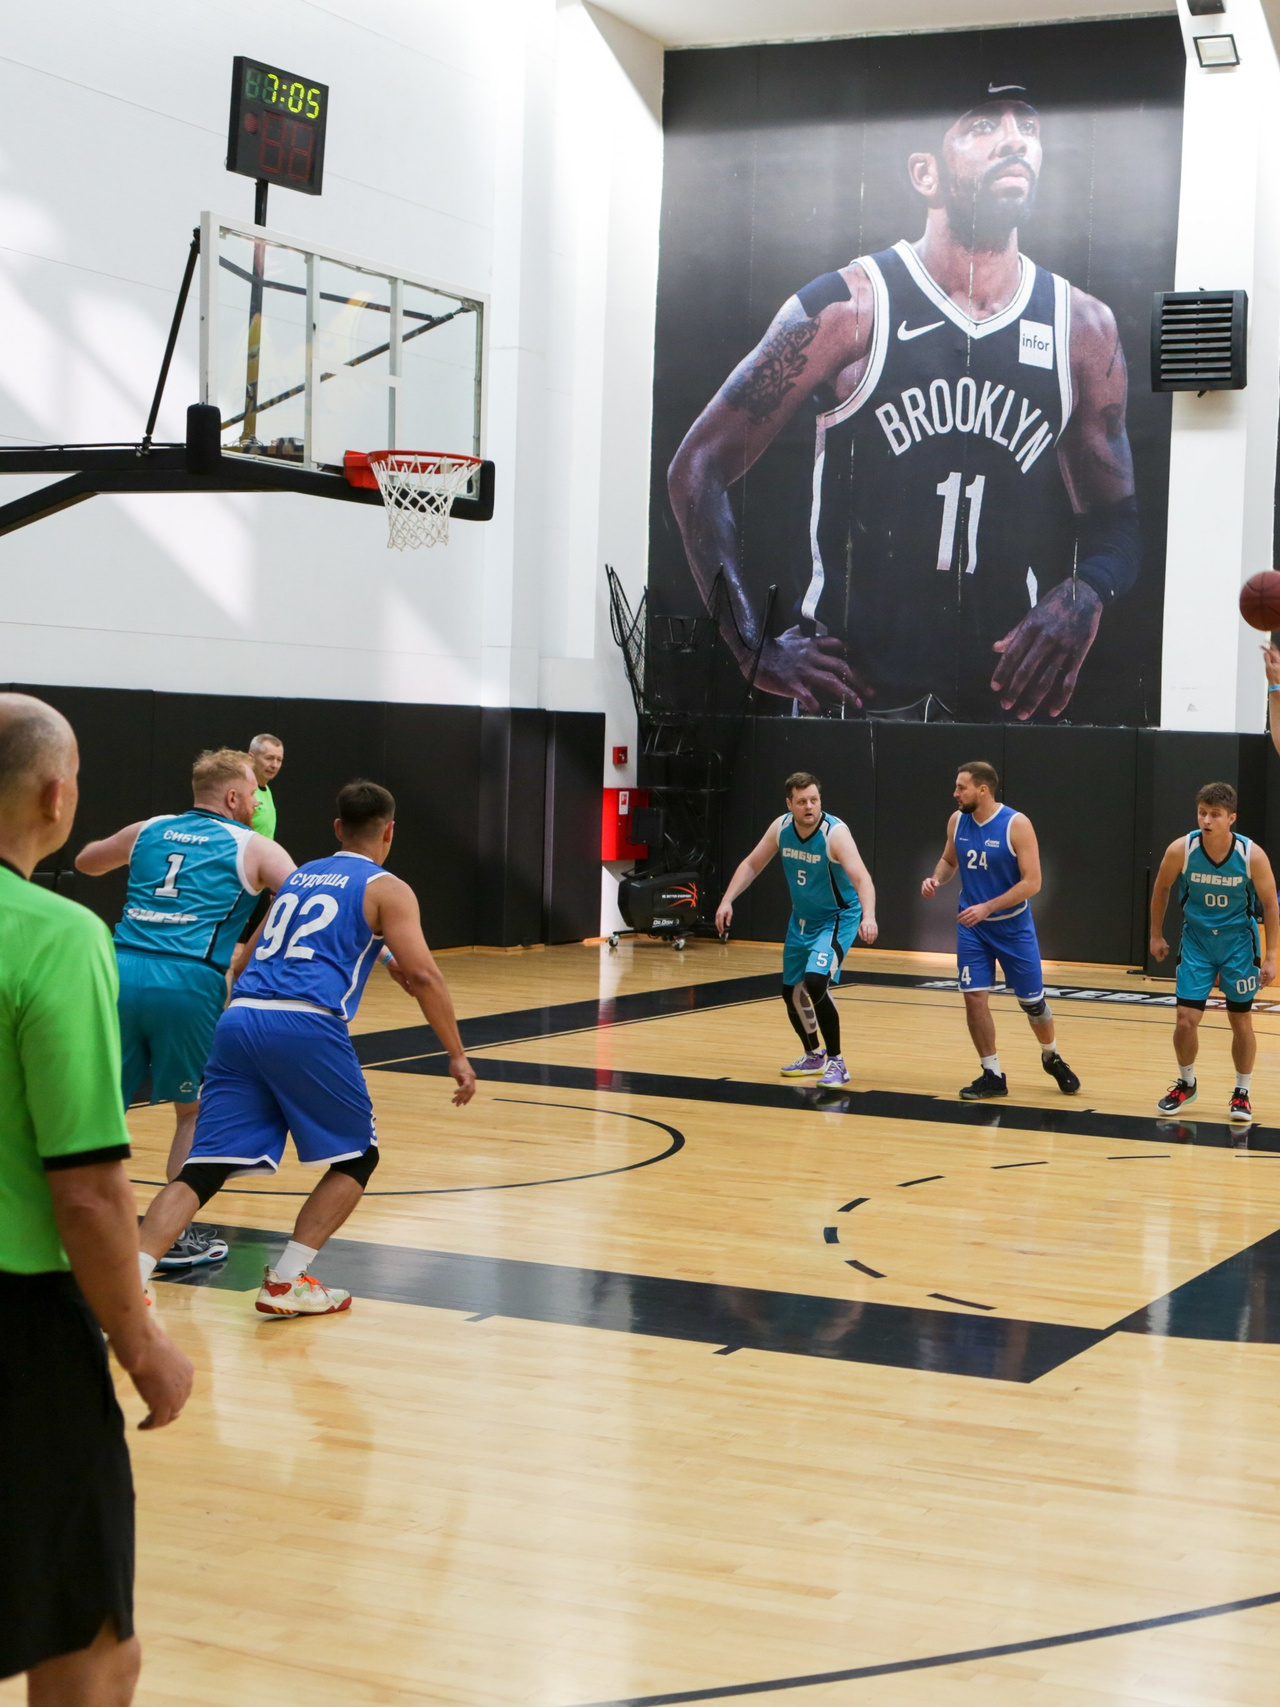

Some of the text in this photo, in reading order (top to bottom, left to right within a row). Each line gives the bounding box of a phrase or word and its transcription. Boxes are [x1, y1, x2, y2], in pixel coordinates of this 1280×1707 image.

[267, 73, 321, 119] 7:05
[1022, 333, 1050, 352] infor
[875, 377, 1053, 474] BROOKLYN
[936, 471, 986, 574] 11
[163, 829, 210, 845] СИБУР
[782, 847, 822, 864] СИБУР
[966, 849, 988, 871] 24
[153, 853, 187, 898] 1
[797, 869, 807, 886] 5
[1190, 872, 1243, 887] СИБУР
[1204, 893, 1229, 908] 00
[255, 892, 339, 961] 92
[815, 952, 829, 968] 5
[1235, 975, 1256, 994] 00
